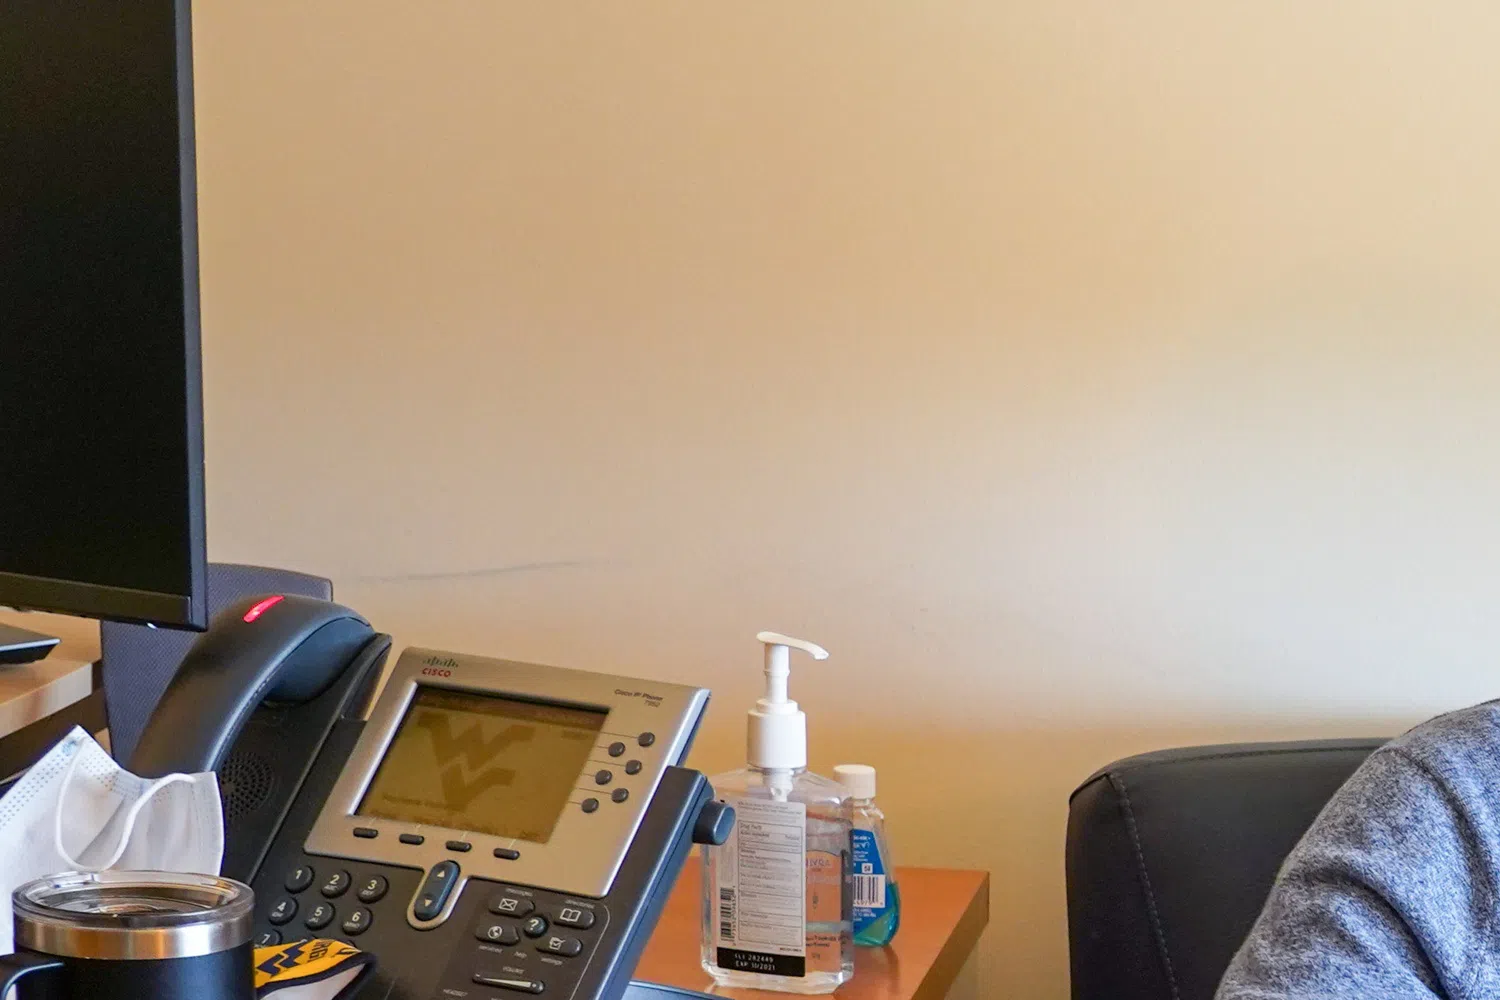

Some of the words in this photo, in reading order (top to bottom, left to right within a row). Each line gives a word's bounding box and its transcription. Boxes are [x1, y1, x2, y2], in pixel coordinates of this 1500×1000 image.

[422, 668, 451, 677] CISCO
[295, 869, 303, 880] 1
[329, 874, 340, 885] 2
[367, 880, 378, 890] 3
[277, 901, 287, 912] 4
[314, 906, 324, 917] 5
[352, 911, 361, 922] 6
[261, 934, 270, 944] 7
